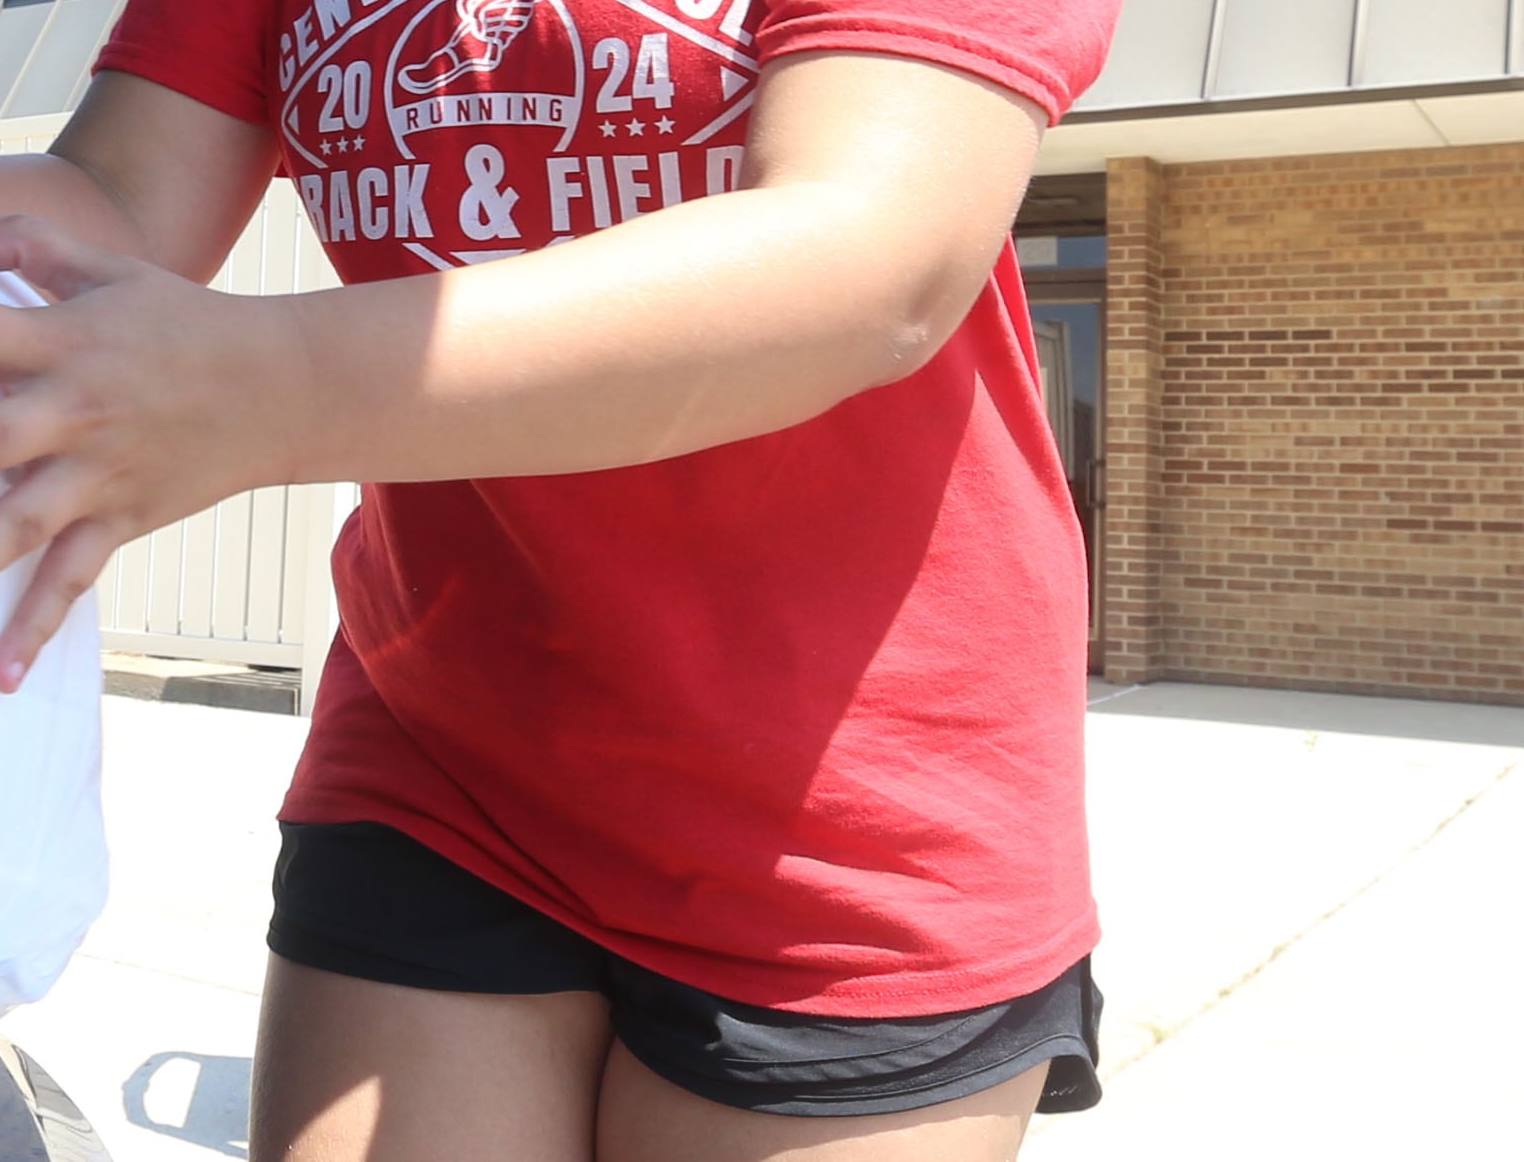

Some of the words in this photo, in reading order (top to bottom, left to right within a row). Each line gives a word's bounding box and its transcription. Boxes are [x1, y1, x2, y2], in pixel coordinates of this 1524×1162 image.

[317, 60, 372, 133] 20
[592, 33, 676, 113] 24
[406, 96, 563, 130] RUNNING
[300, 163, 434, 242] RACK
[459, 143, 522, 241] &
